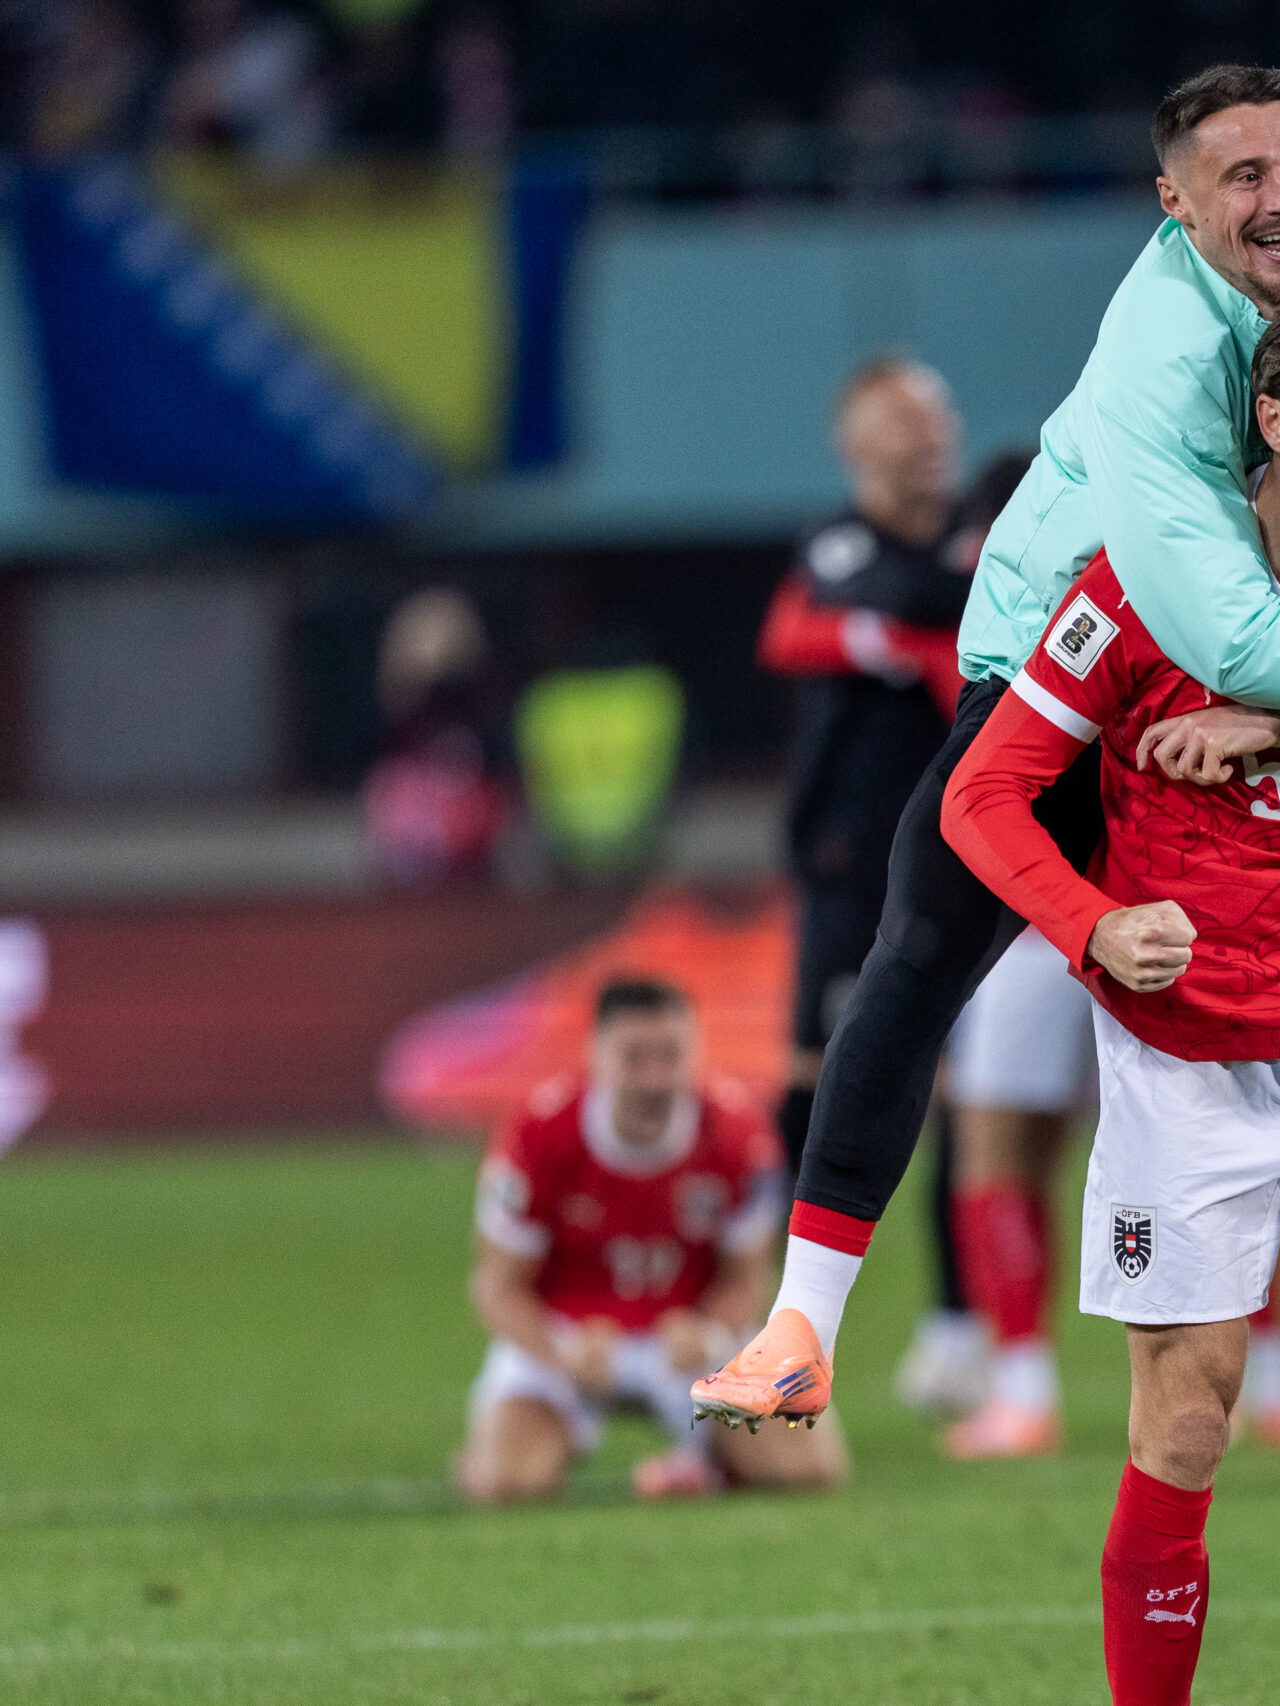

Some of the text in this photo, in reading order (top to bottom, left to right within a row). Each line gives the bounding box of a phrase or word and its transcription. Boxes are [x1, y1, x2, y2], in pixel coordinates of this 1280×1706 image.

[1065, 638, 1076, 650] FIFA
[1121, 1209, 1141, 1219] ÖFB
[1146, 1581, 1198, 1602] ÖFB
